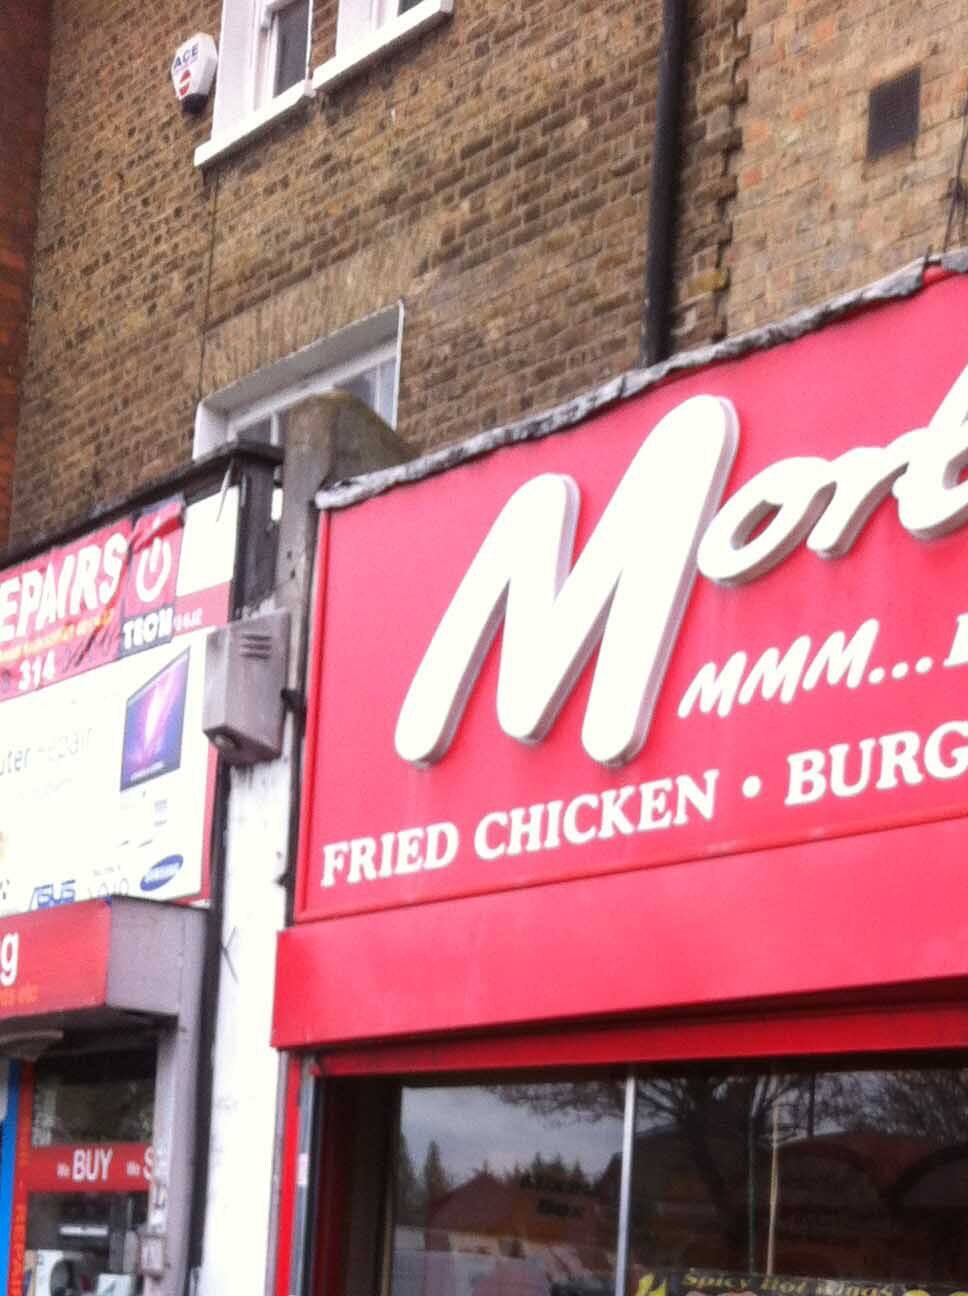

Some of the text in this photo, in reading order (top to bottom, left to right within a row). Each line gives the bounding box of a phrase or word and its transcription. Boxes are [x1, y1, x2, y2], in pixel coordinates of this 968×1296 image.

[321, 823, 459, 887] FRIED
[474, 770, 719, 860] CHICKEN
[72, 1149, 112, 1181] BUY
